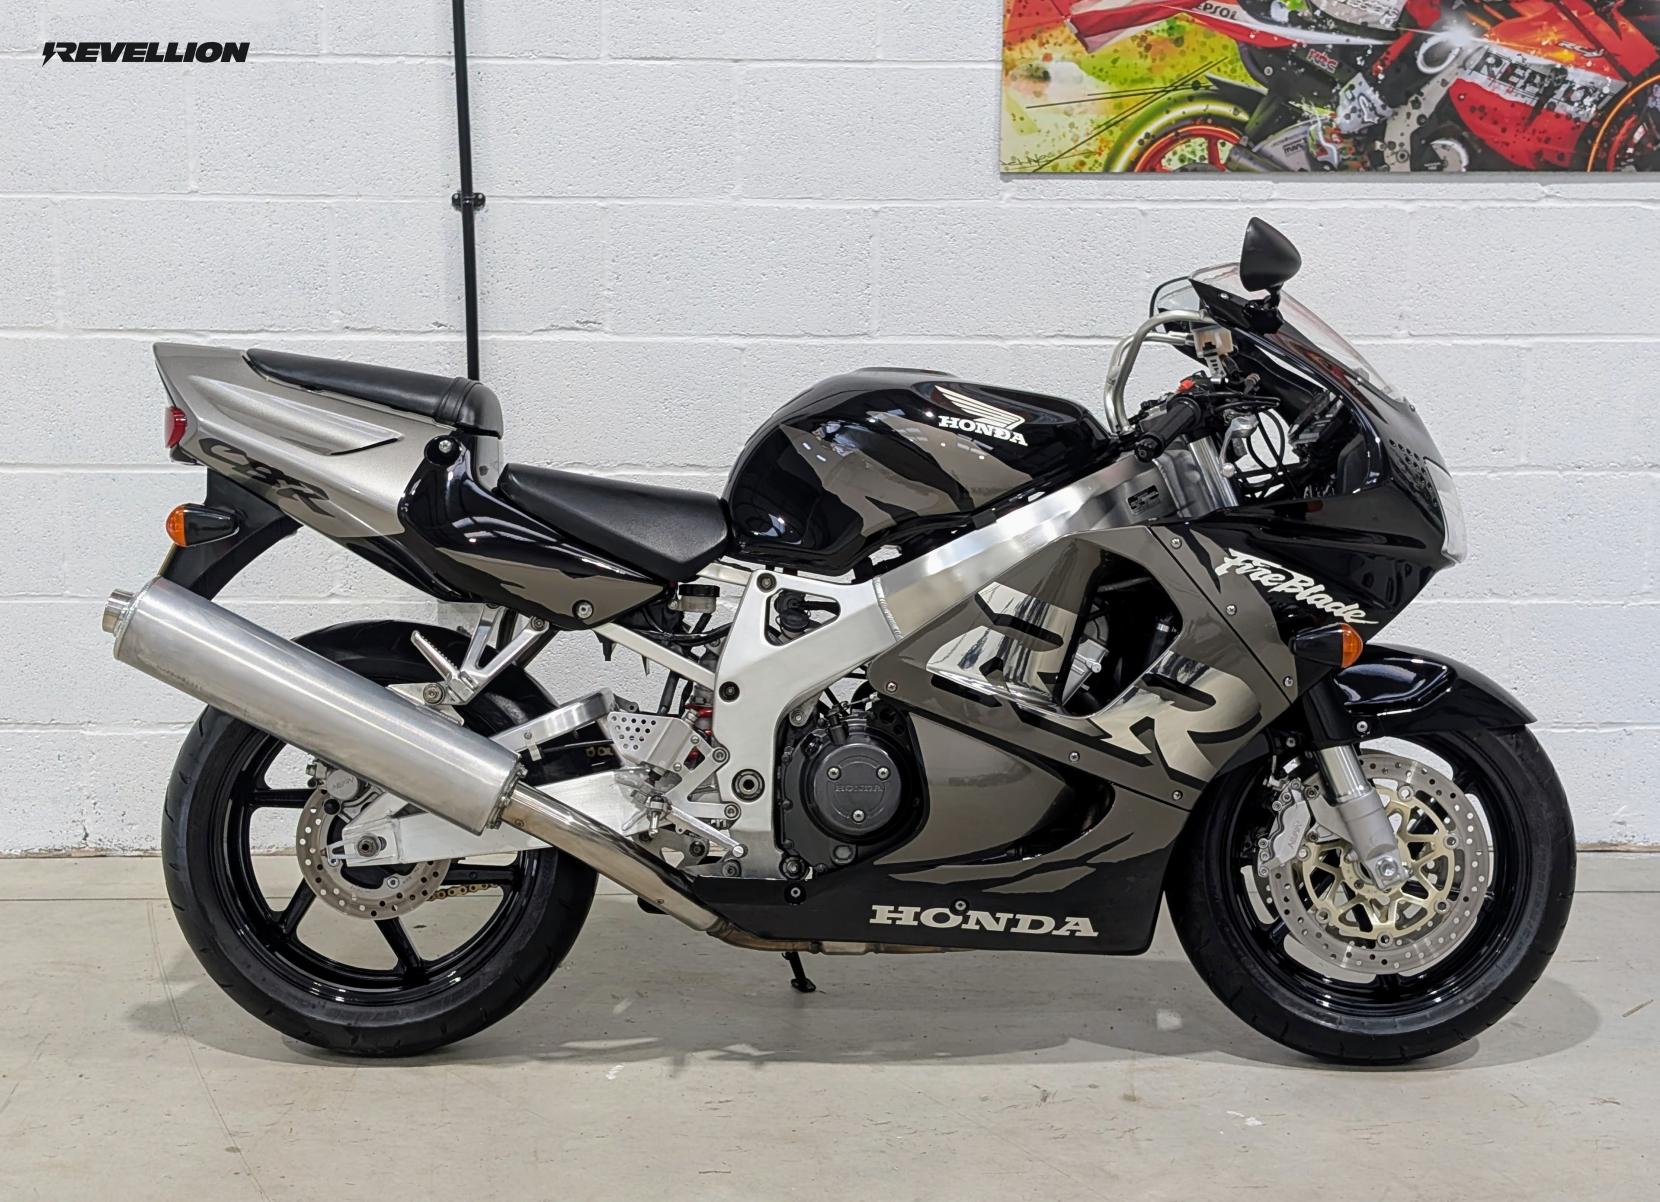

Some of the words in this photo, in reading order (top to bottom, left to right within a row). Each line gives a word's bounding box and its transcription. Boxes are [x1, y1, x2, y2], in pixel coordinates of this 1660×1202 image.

[938, 415, 1028, 446] HONDA
[199, 437, 336, 518] CBR
[1215, 548, 1379, 625] FireBlade
[869, 904, 1099, 937] HONDA
